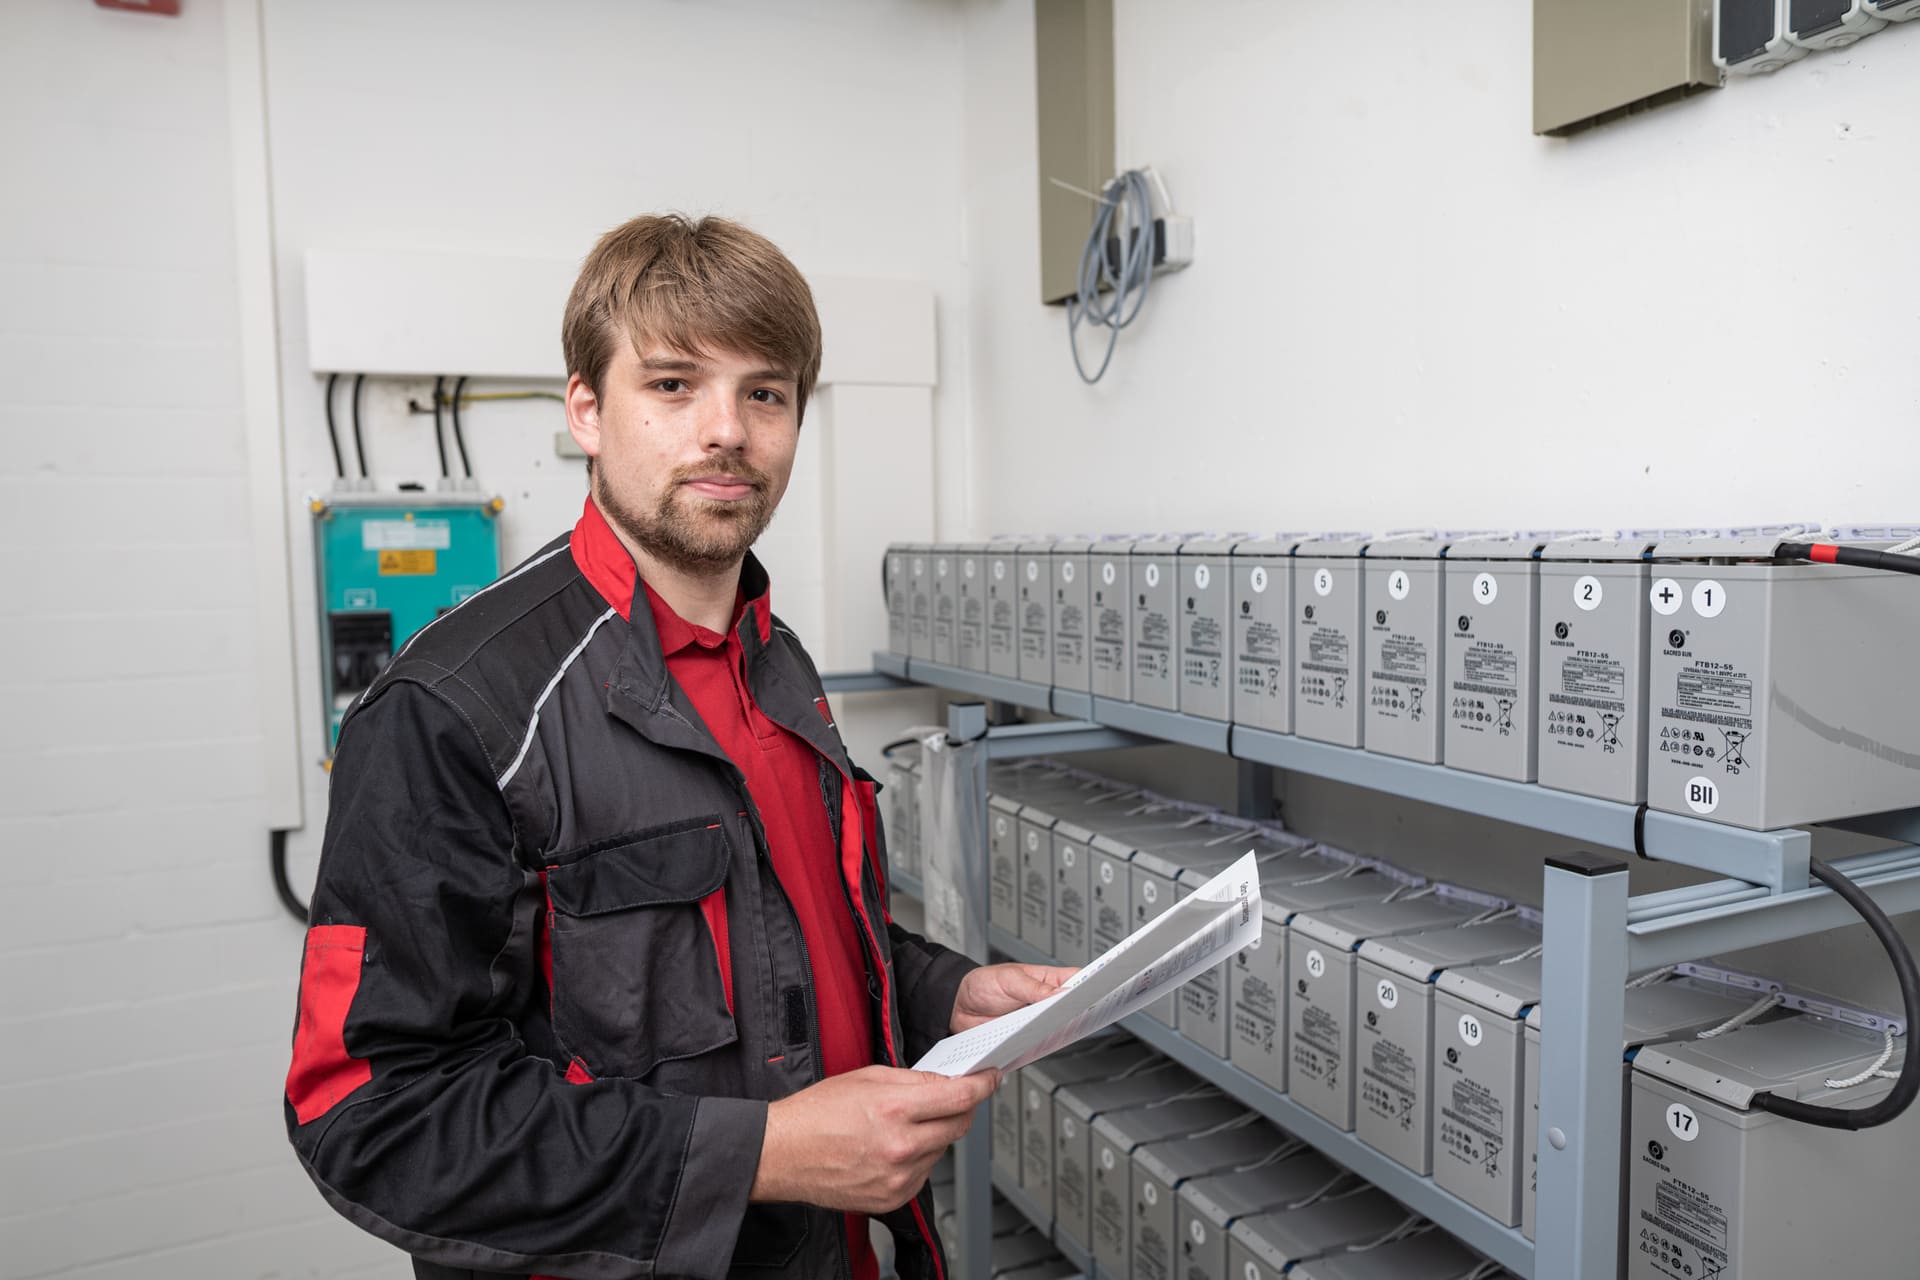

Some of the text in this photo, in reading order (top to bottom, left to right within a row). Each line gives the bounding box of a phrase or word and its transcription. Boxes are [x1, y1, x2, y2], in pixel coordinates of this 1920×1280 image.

[1256, 573, 1262, 586] 6
[1320, 575, 1327, 588] 5
[1395, 577, 1402, 592] 4
[1481, 580, 1489, 596] 3
[1583, 584, 1593, 600] 2
[1704, 589, 1712, 607] 1
[1577, 650, 1609, 659] FTB12-55
[1663, 649, 1681, 657] SACRED
[1695, 661, 1734, 671] FTB12-55
[1603, 744, 1615, 754] Pb
[1726, 764, 1740, 775] Pb
[1690, 784, 1713, 804] BII
[1310, 958, 1321, 971] 21
[1381, 985, 1394, 1001] 20
[1464, 1021, 1478, 1038] 19
[1673, 1111, 1693, 1131] 17
